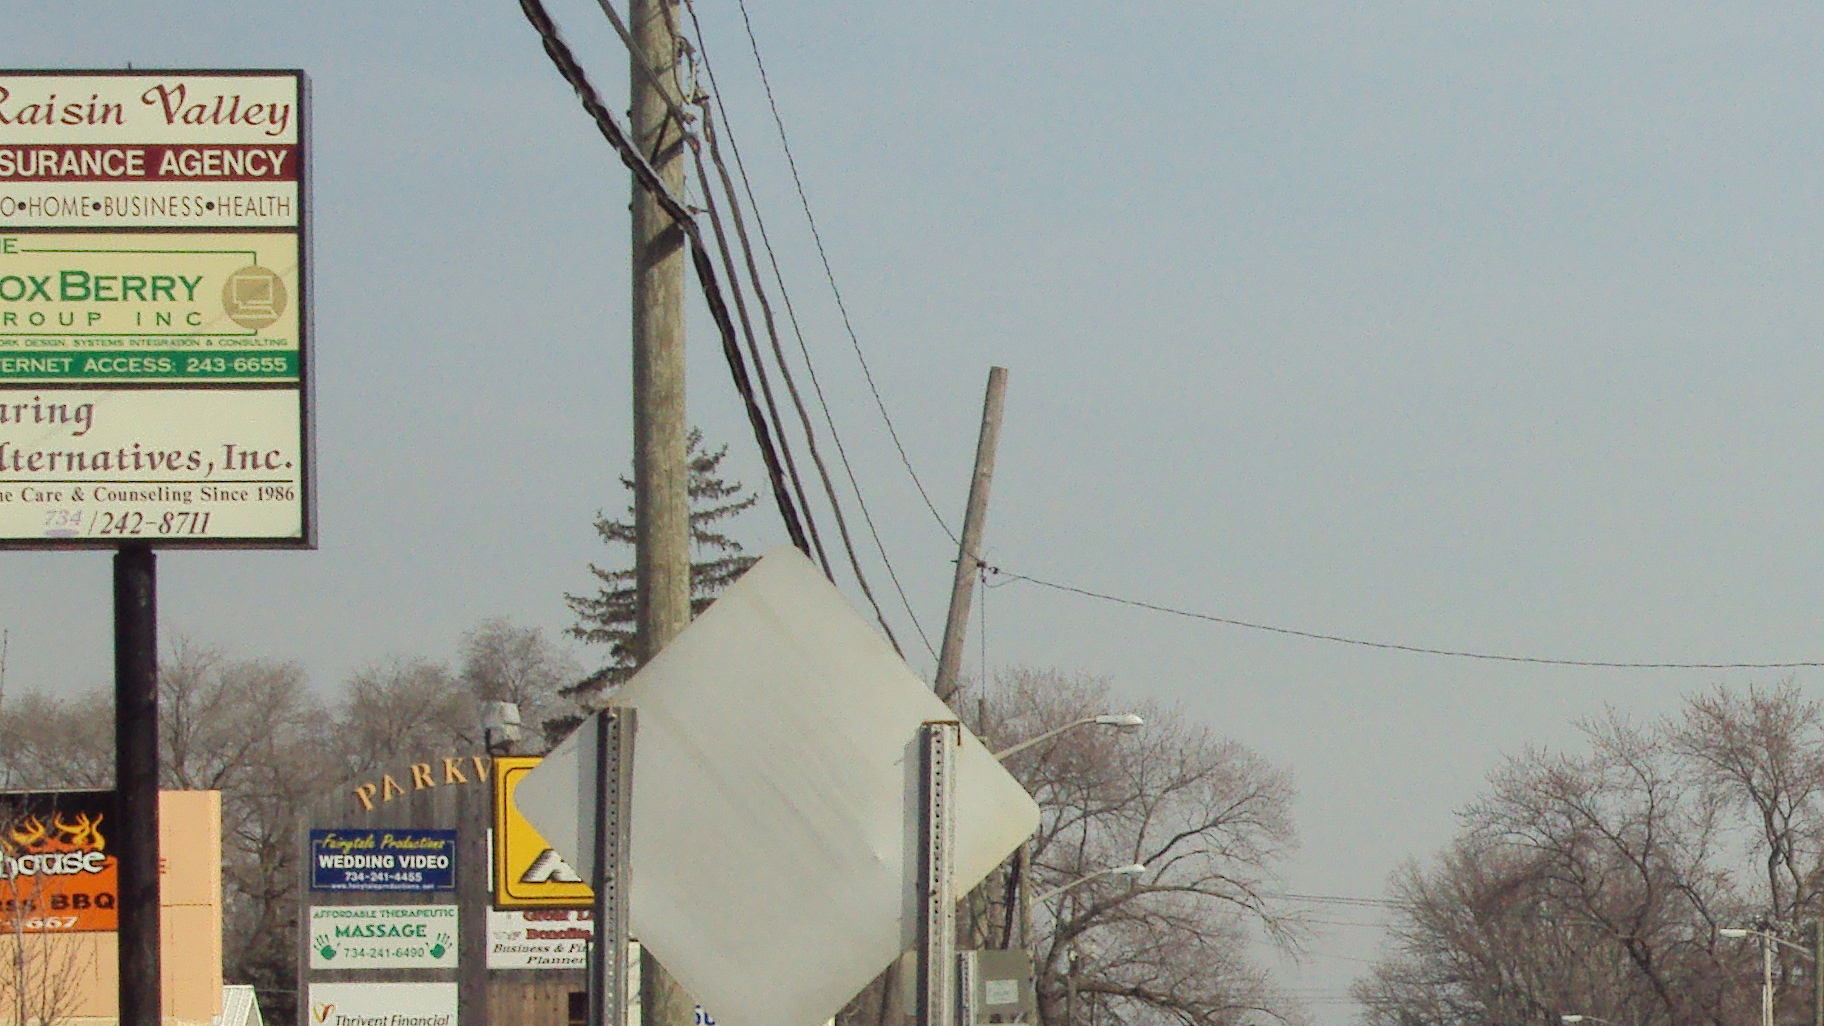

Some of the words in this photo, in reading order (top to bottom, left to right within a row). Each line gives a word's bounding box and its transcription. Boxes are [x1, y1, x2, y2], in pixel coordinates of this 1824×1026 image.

[141, 83, 290, 136] Valley
[0, 149, 146, 177] SURANCE
[158, 149, 288, 177] AGENCY
[3, 311, 101, 326] ROUP
[136, 312, 202, 327] INC
[73, 338, 124, 348] SYSTEMS
[129, 338, 200, 348] INTEGRATION
[218, 338, 288, 348] CONSULTING
[83, 357, 177, 373] ACCESS:
[186, 357, 288, 373] 243-6655
[21, 486, 63, 502] Care
[71, 487, 85, 502] &
[94, 486, 193, 504] Counseling
[200, 486, 249, 501] Since
[257, 486, 295, 501] 1986
[318, 854, 395, 869] WEDDING
[399, 854, 449, 869] VIDEO
[51, 892, 115, 910] BBQ
[313, 909, 377, 919] AFFORDABLE
[379, 908, 455, 918] THERAPEUTIC
[335, 923, 427, 938] MASSAGE
[492, 943, 551, 953] Business
[553, 944, 564, 953] &
[336, 1014, 388, 1026] Thrivent
[391, 1014, 450, 1026] Financial
